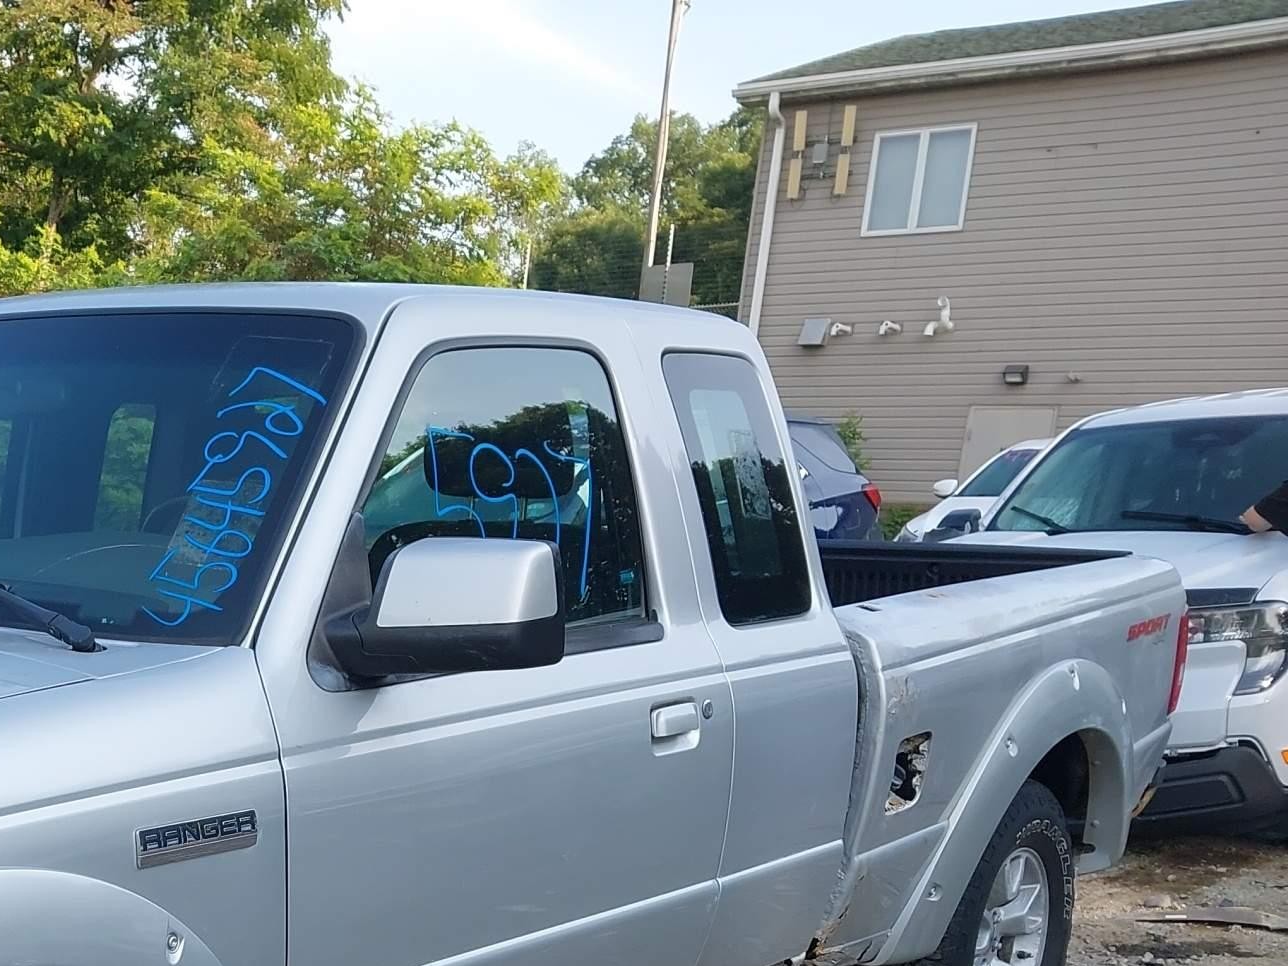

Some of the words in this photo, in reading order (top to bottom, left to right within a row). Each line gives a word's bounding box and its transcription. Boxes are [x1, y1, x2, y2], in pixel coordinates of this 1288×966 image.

[141, 366, 328, 626] 45645927
[1126, 613, 1172, 642] SPORT
[140, 815, 258, 852] RANGER
